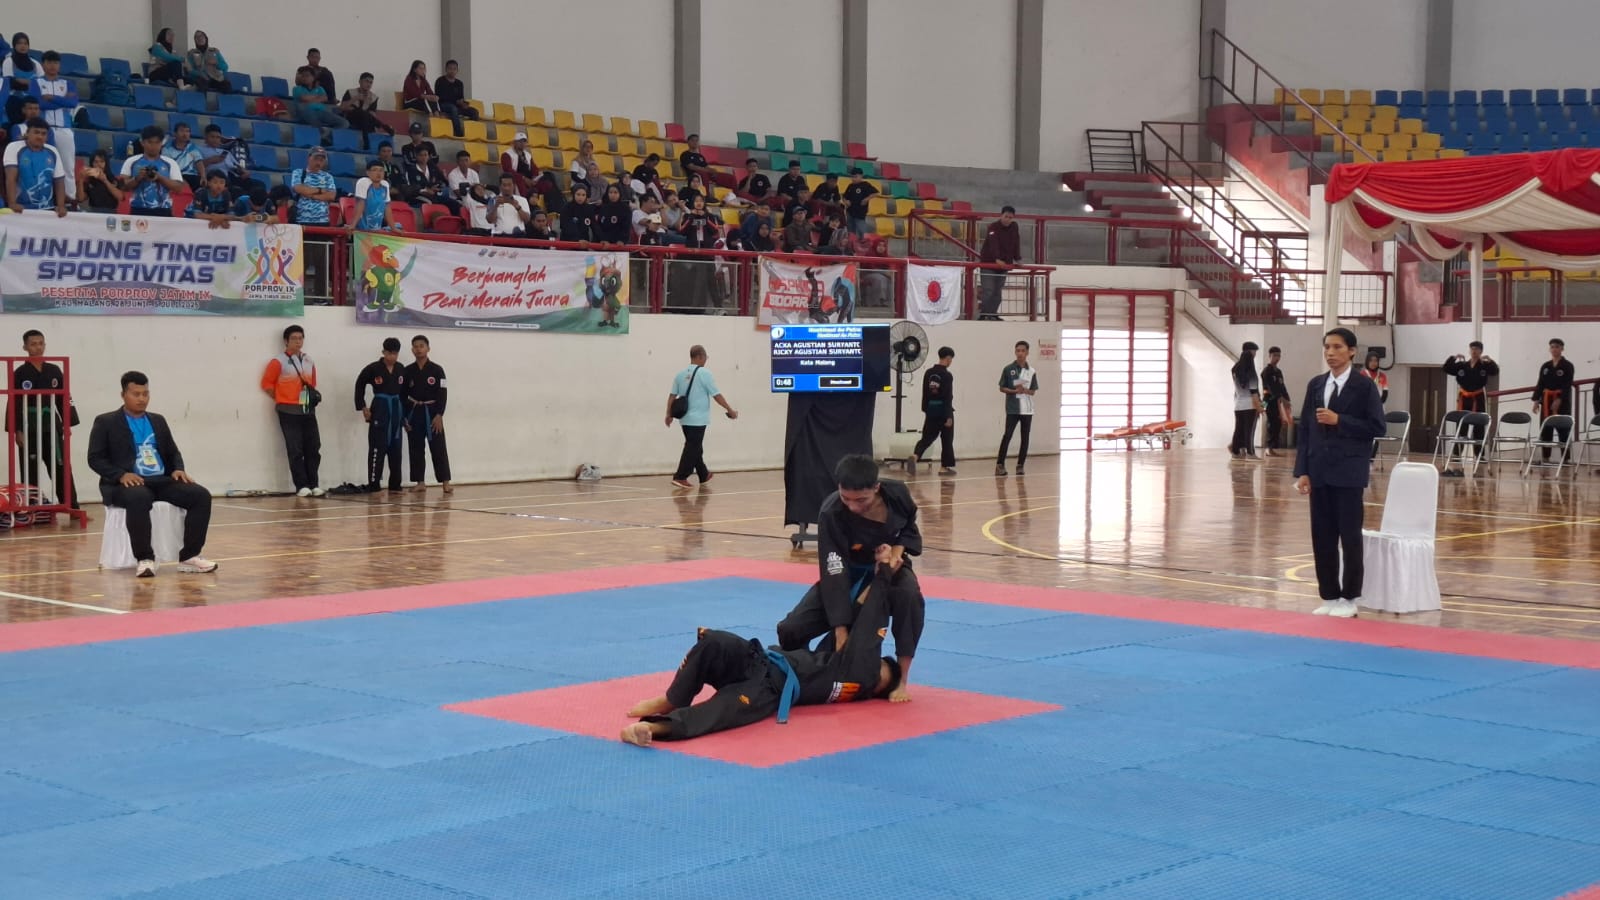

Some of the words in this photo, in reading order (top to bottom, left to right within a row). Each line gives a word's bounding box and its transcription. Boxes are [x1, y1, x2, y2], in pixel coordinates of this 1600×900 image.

[10, 237, 143, 260] JUNJUNG
[152, 242, 237, 263] TINGGI
[37, 262, 215, 284] SPORTIVITAS
[450, 265, 546, 290] Berjuanglah
[41, 287, 97, 298] PESERTA
[101, 287, 157, 300] PORPROV
[159, 289, 195, 300] JATIM
[245, 284, 283, 292] PORPROV
[422, 291, 466, 310] Demi
[468, 288, 524, 310] Meraih
[525, 290, 569, 309] Juara
